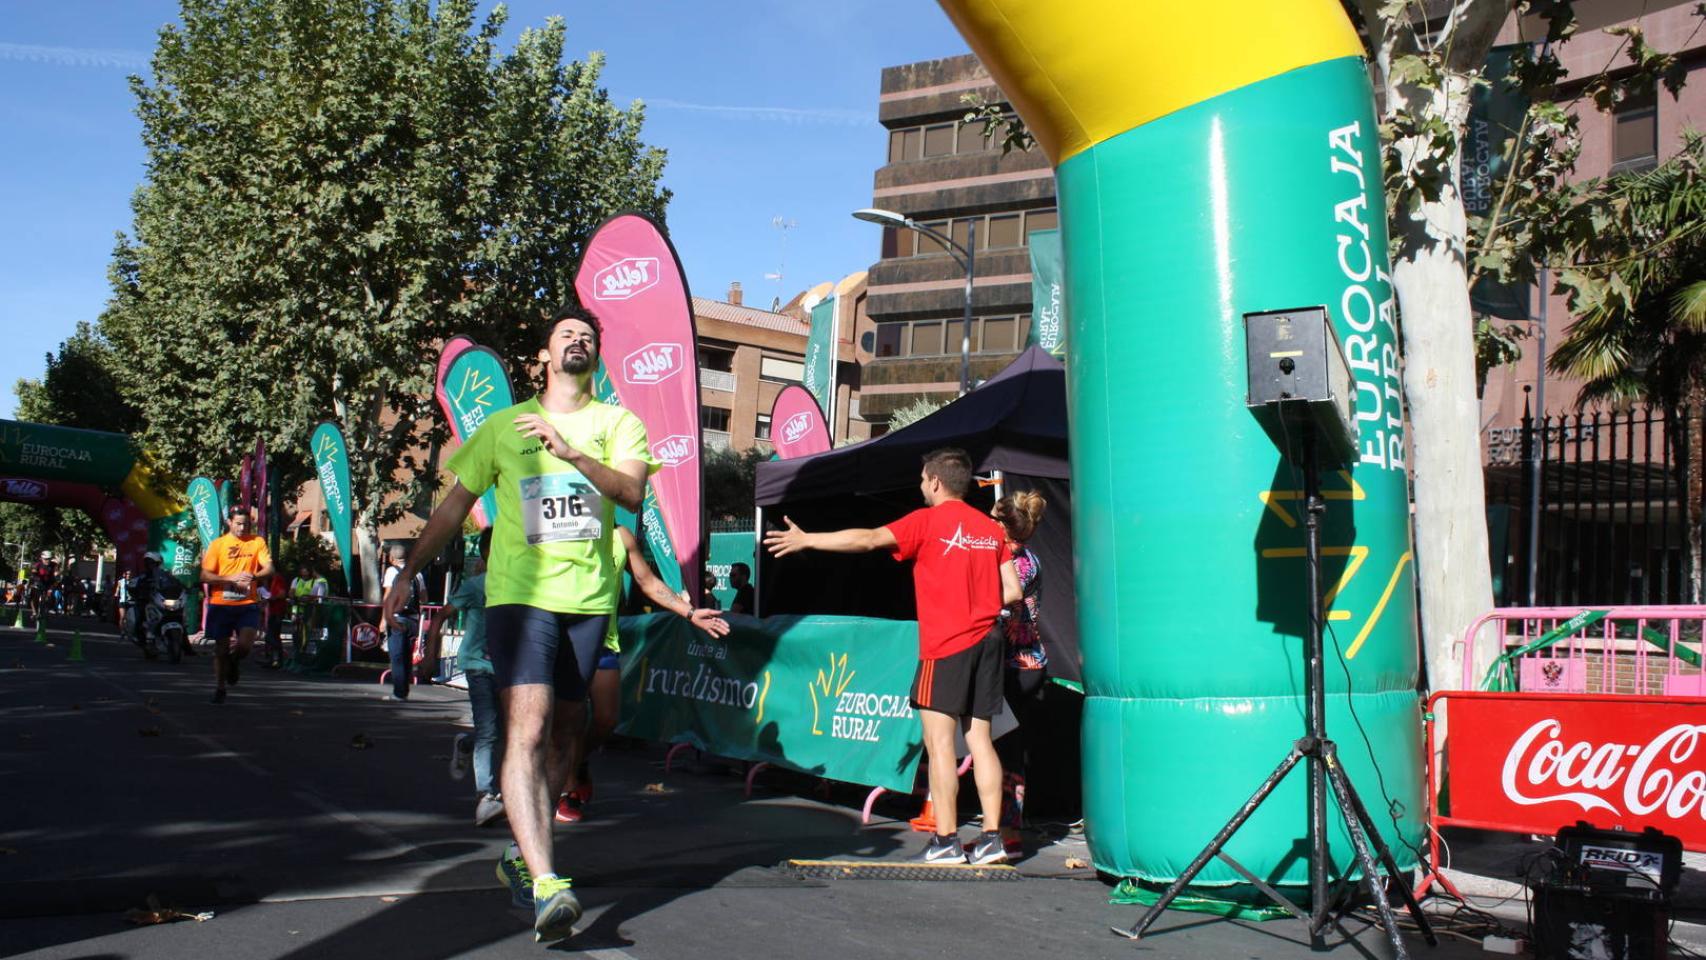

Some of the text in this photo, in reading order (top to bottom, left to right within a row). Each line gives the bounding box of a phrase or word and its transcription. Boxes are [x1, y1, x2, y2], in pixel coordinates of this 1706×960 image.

[1329, 121, 1386, 470] EUROCAJA
[20, 454, 67, 469] RURAL
[22, 443, 92, 462] EUROCAJA
[541, 495, 582, 520] 376
[647, 656, 758, 710] ruralismo
[836, 691, 914, 719] EUROCAJA
[832, 715, 881, 742] RURAL
[1502, 719, 1706, 821] Coca-Co
